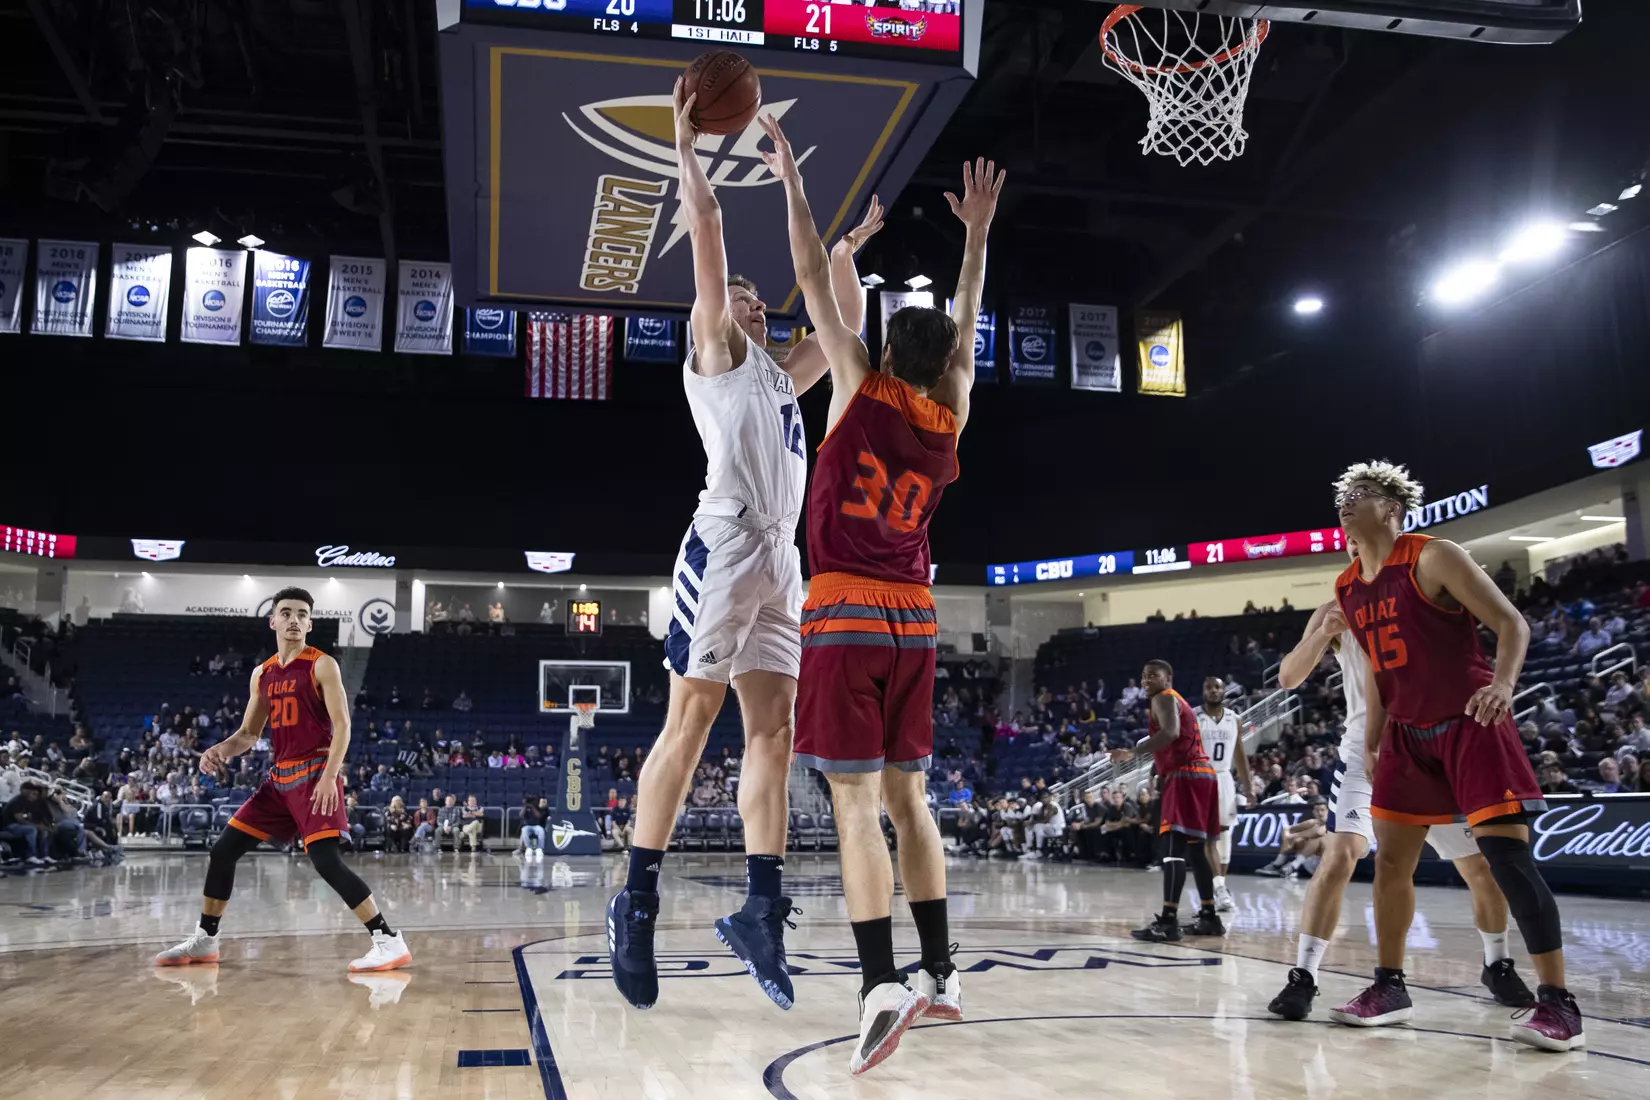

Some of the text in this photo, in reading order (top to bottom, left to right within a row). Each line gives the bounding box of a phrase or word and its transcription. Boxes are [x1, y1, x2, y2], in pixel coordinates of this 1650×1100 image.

[593, 18, 638, 33] FLS 4
[805, 4, 831, 34] 21
[687, 28, 753, 42] 1ST HALF
[874, 22, 920, 38] SPIRIT
[794, 37, 837, 52] FLS 5
[579, 174, 669, 294] LANCERS
[50, 247, 85, 260] 2018
[112, 272, 162, 283] BASKETBAL
[341, 264, 373, 276] 2015
[410, 269, 442, 280] 2014
[194, 279, 241, 288] ASKETBALL
[343, 277, 369, 285] MEN'S
[412, 281, 438, 289] MEN'S
[331, 285, 382, 294] BASKETBALL
[193, 315, 225, 323] DIVISION
[1079, 312, 1108, 321] 2017
[331, 320, 370, 329] DIVISION
[841, 451, 933, 533] 30
[315, 545, 395, 568] Cadillac
[1145, 547, 1177, 565] 11:06
[1206, 543, 1224, 563] 21
[1036, 559, 1073, 581] CBU
[1098, 554, 1116, 574] 20
[185, 606, 249, 615] ACADEMICALLY
[313, 609, 353, 618] IBLICALLY
[572, 602, 600, 615] 11:06
[579, 614, 596, 632] 14
[1366, 623, 1409, 673] 15
[270, 697, 299, 729] 20
[1213, 742, 1225, 761] 0
[566, 757, 582, 812] CBU
